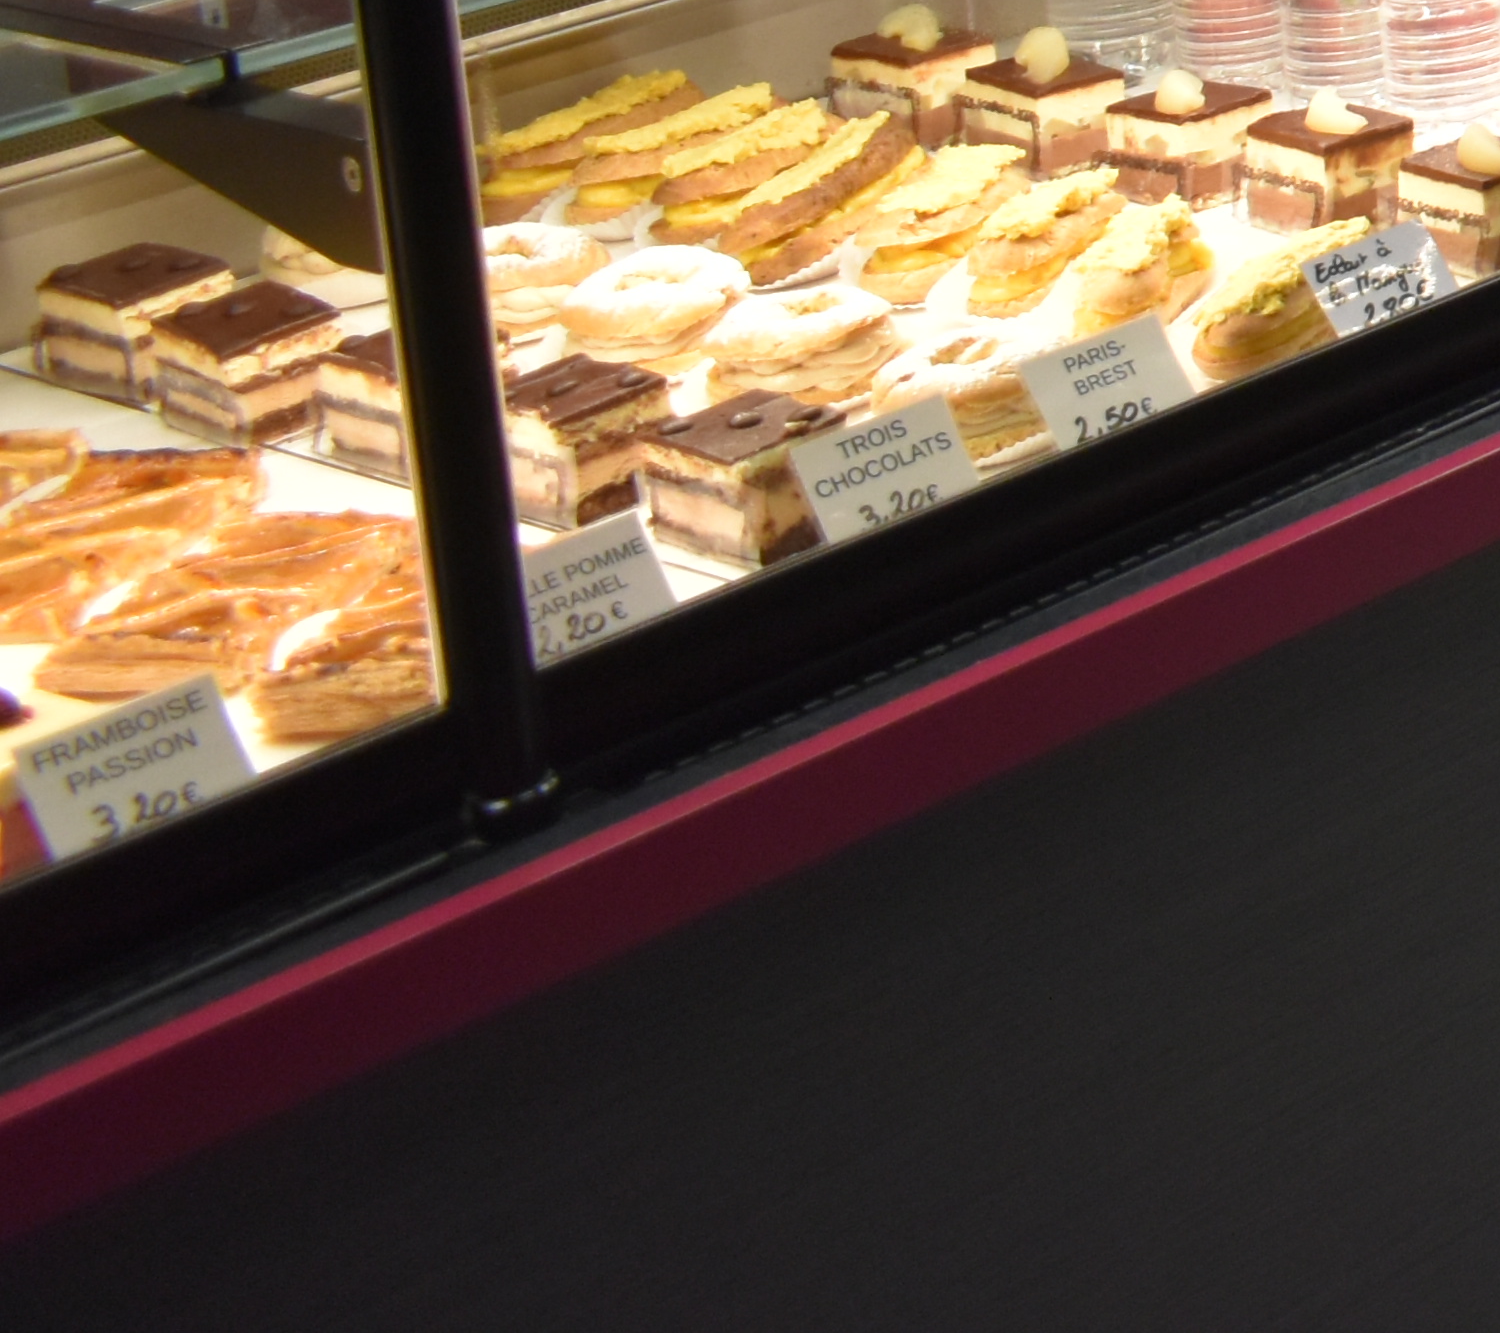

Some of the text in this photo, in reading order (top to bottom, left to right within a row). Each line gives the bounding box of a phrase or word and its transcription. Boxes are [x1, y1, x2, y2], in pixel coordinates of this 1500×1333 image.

[1063, 340, 1126, 373] PARIS-
[1073, 359, 1138, 396] BREST
[835, 419, 908, 461] TROIS
[1074, 397, 1159, 444] 2,50€
[814, 431, 953, 499] CHOCOLATS
[565, 538, 647, 583] POMME
[31, 689, 208, 774] FRAMBOISE
[65, 728, 200, 796] PASSION
